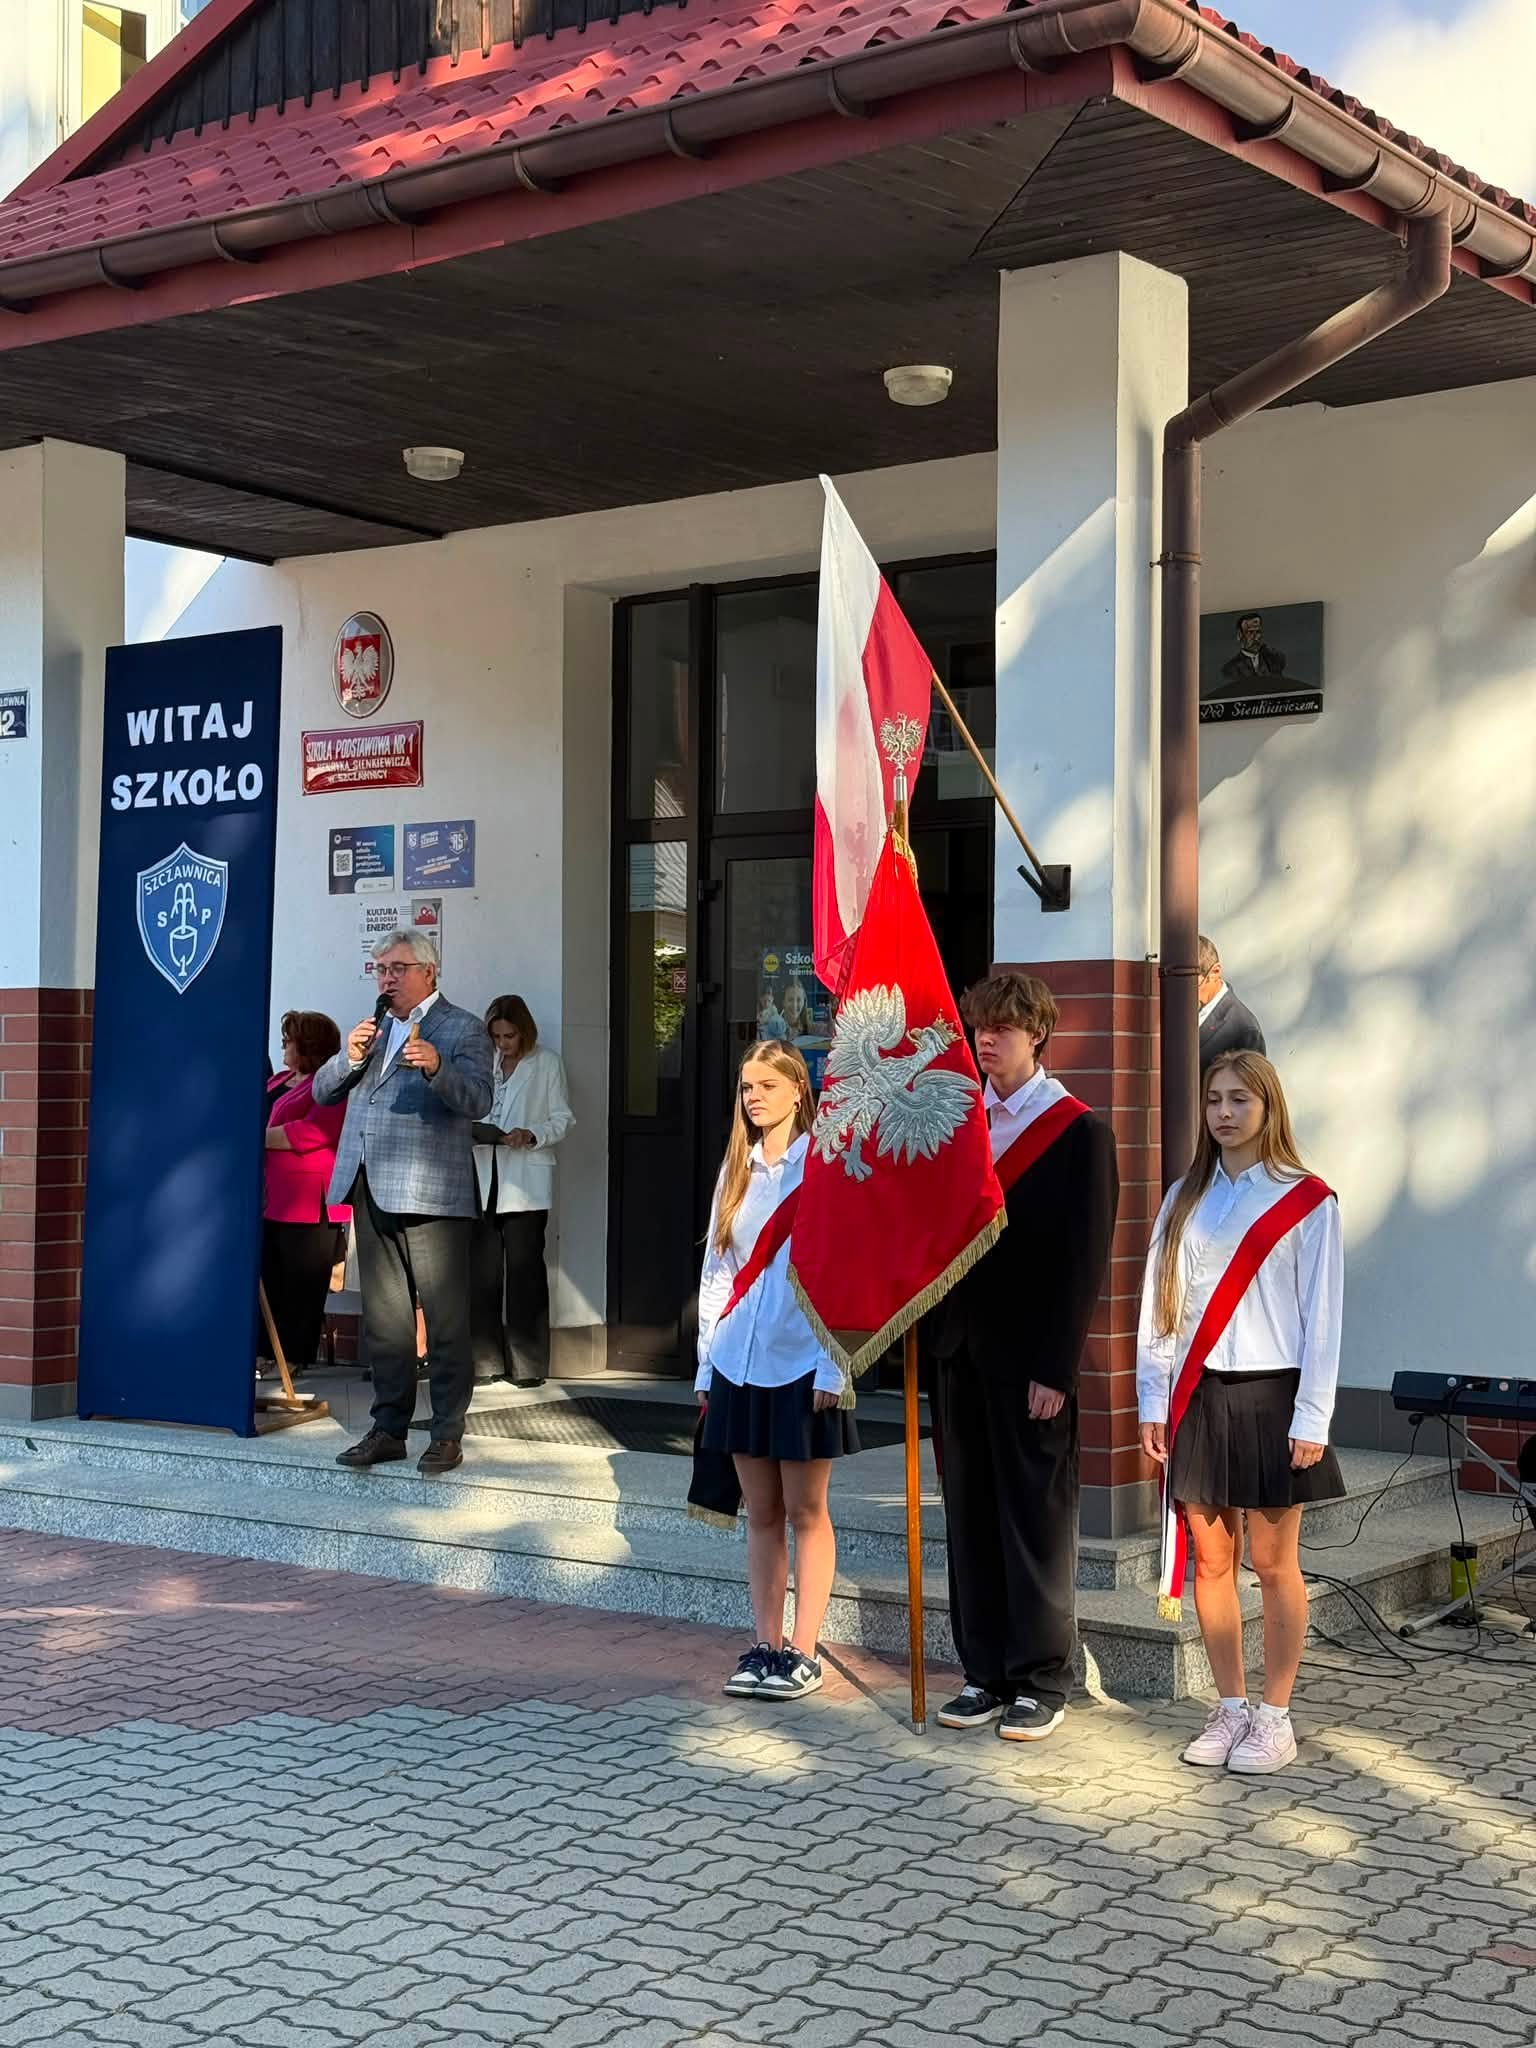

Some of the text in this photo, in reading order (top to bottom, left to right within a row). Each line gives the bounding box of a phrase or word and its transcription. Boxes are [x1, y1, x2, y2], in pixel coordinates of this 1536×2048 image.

[127, 701, 253, 747] WITAJ
[335, 735, 391, 759] PODSTAWOWA
[393, 734, 406, 755] NR
[409, 733, 414, 754] 1
[352, 756, 411, 770] SIENKIEWICZA
[111, 763, 263, 811] SZKOŁO
[144, 864, 221, 896] SZCZAWNICA
[157, 908, 212, 928] S P
[366, 908, 398, 916] KULTURA
[178, 955, 188, 977] 1
